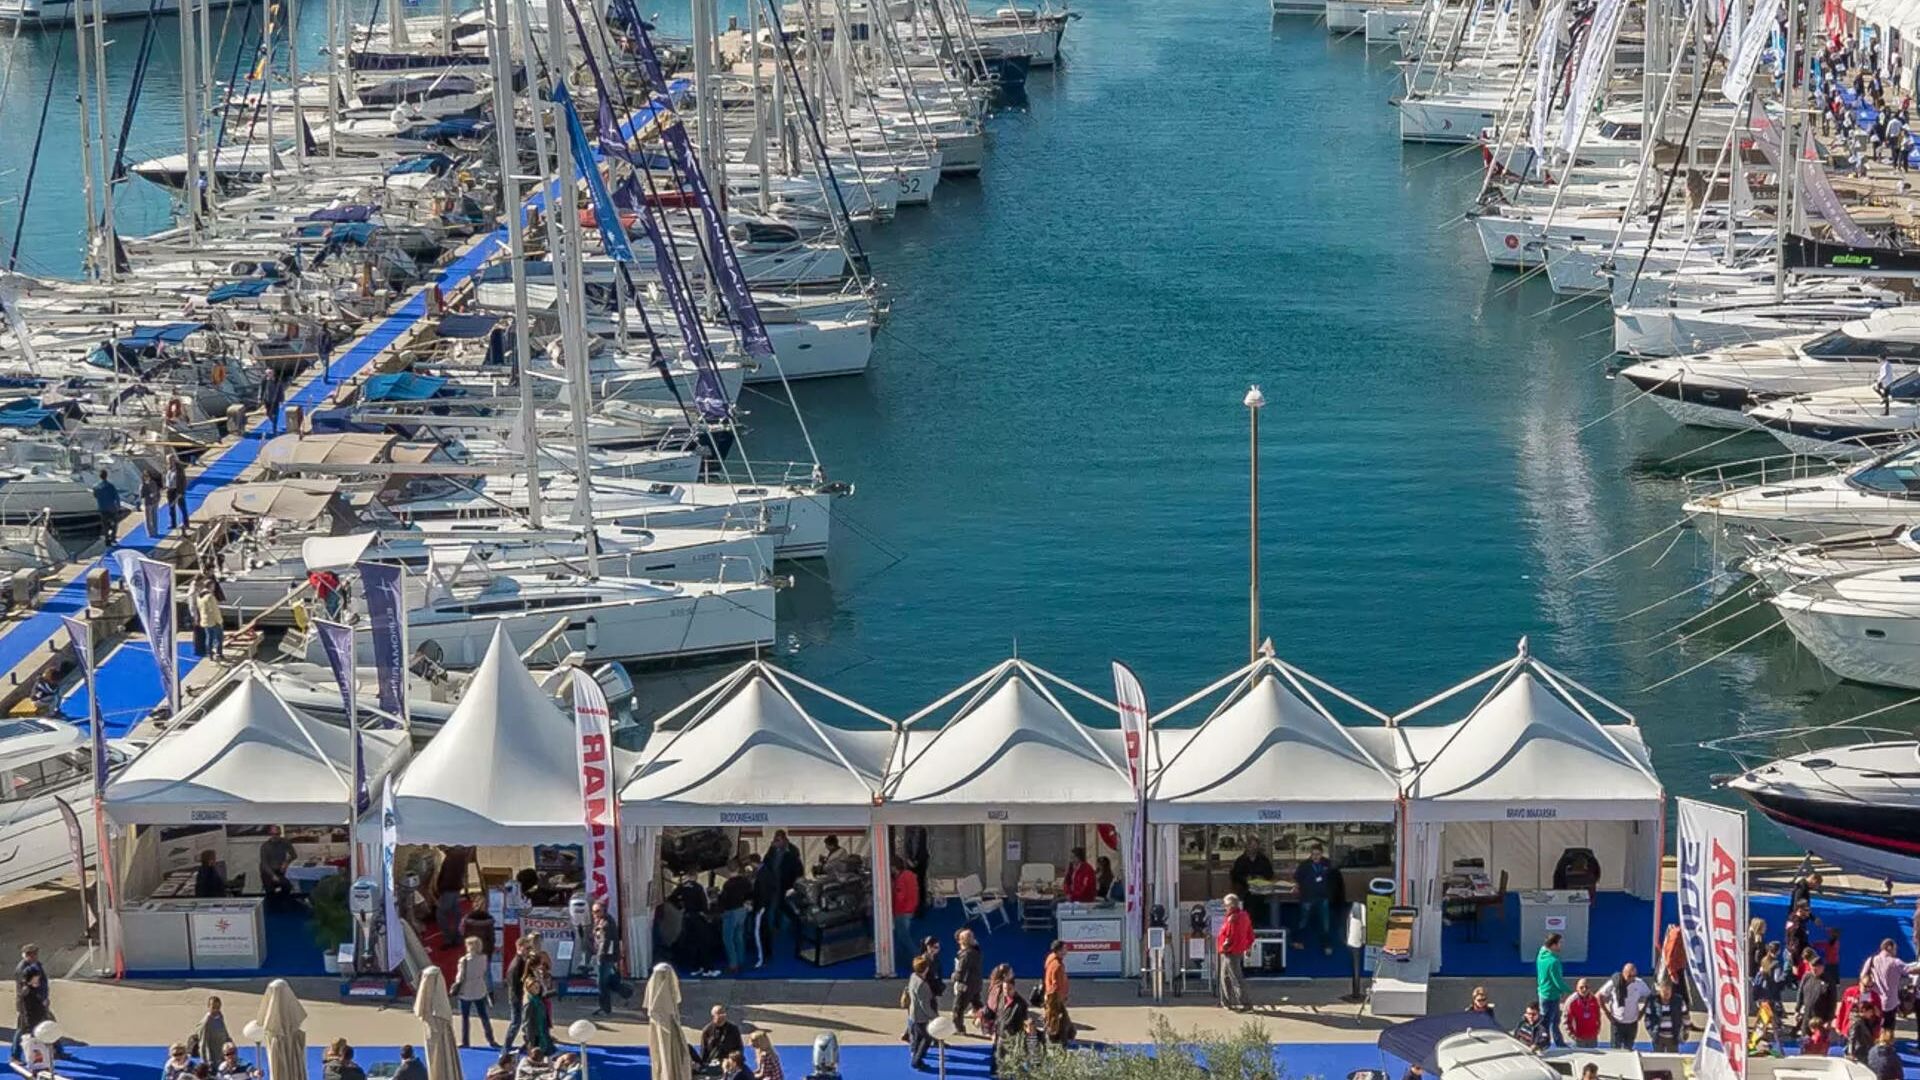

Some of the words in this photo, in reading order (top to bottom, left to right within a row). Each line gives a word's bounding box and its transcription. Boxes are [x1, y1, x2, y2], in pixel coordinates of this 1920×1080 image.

[698, 181, 745, 298] JEANNEAU
[1832, 254, 1872, 264] elan
[525, 918, 568, 929] HOND
